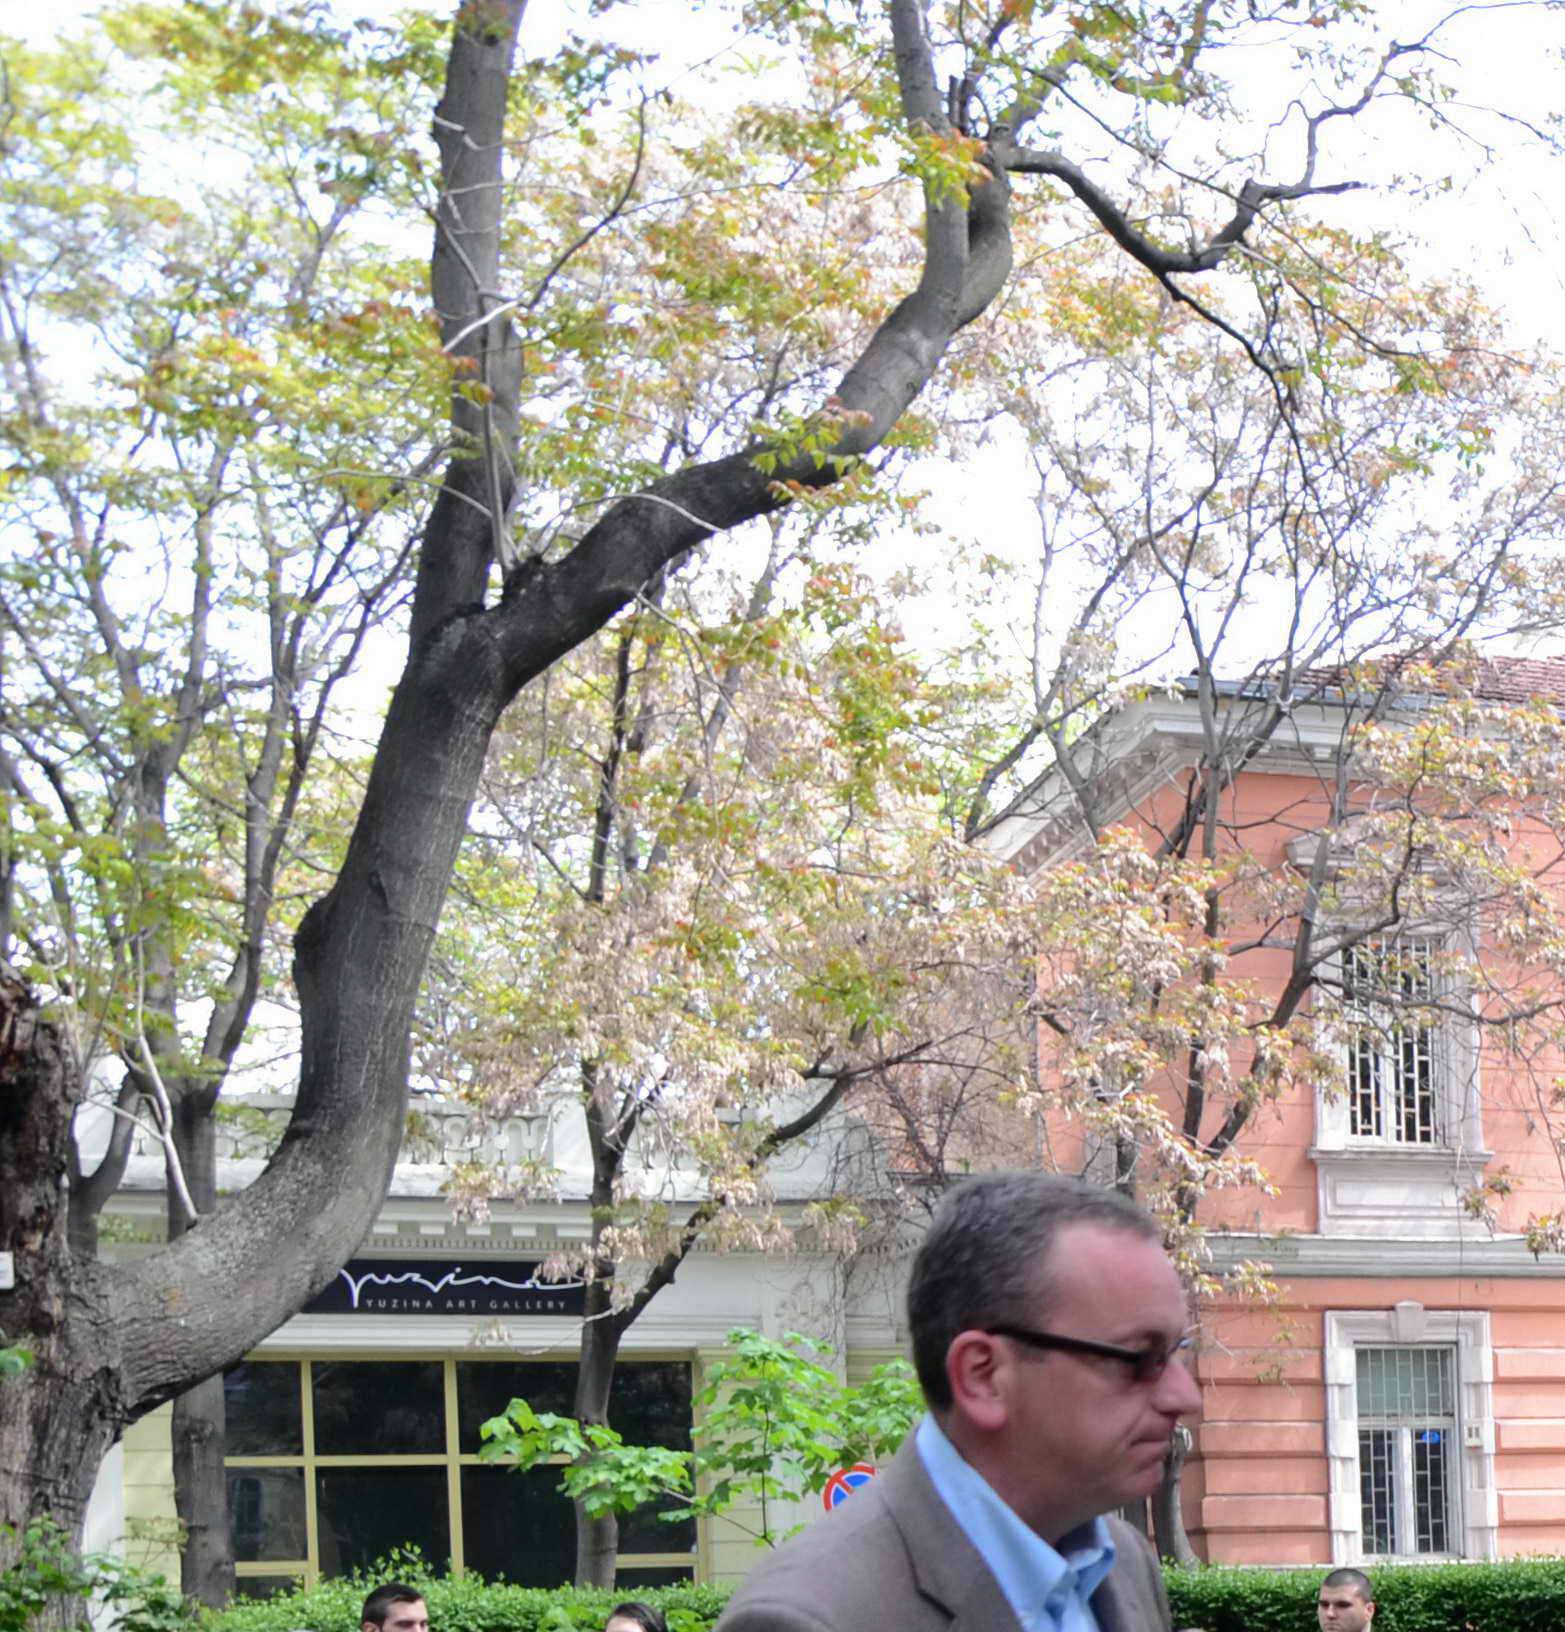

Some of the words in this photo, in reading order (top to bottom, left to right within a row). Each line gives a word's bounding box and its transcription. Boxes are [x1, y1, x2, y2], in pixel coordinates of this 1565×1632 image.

[366, 1299, 433, 1310] YUZINA
[446, 1299, 477, 1310] ART
[489, 1299, 566, 1310] GALLERY
